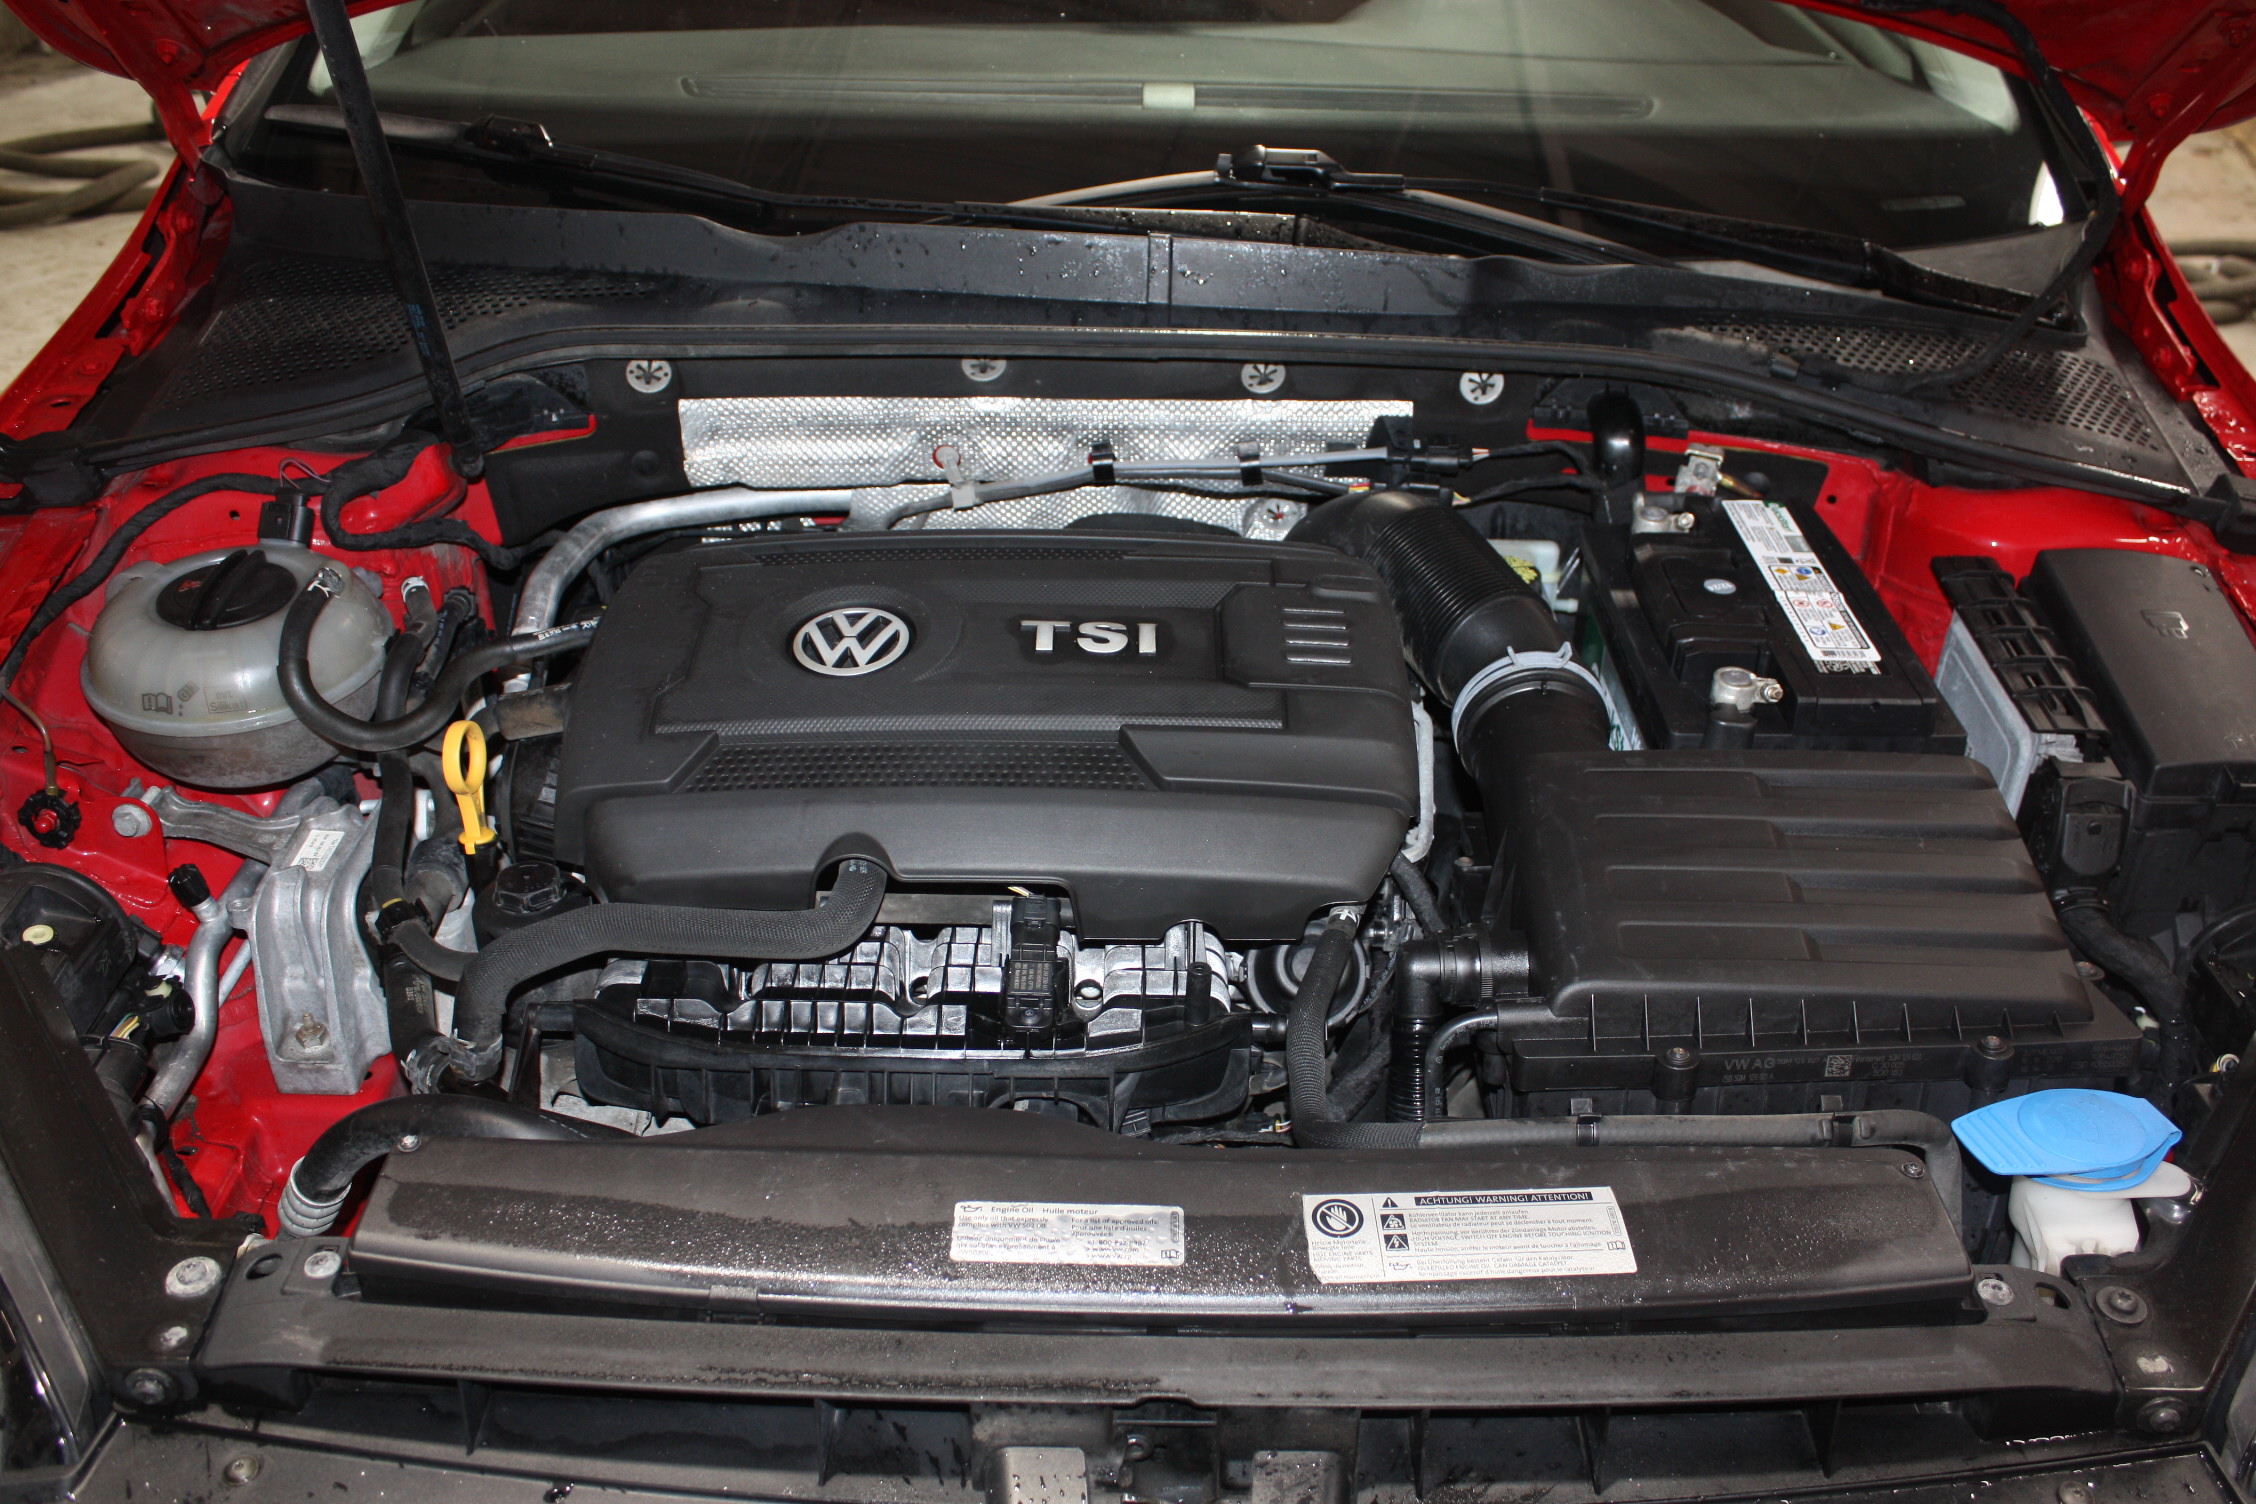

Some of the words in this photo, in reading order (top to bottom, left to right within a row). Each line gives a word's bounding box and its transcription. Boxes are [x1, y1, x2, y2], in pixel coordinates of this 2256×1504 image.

[1021, 620, 1158, 654] TSI
[1724, 1058, 1750, 1071] VW
[1752, 1057, 1776, 1069] AG
[1420, 1196, 1473, 1205] ACHTUNG!
[1475, 1194, 1529, 1203] WARNING!
[1531, 1192, 1589, 1202] ATTENTION!
[991, 1206, 1020, 1215] Engine
